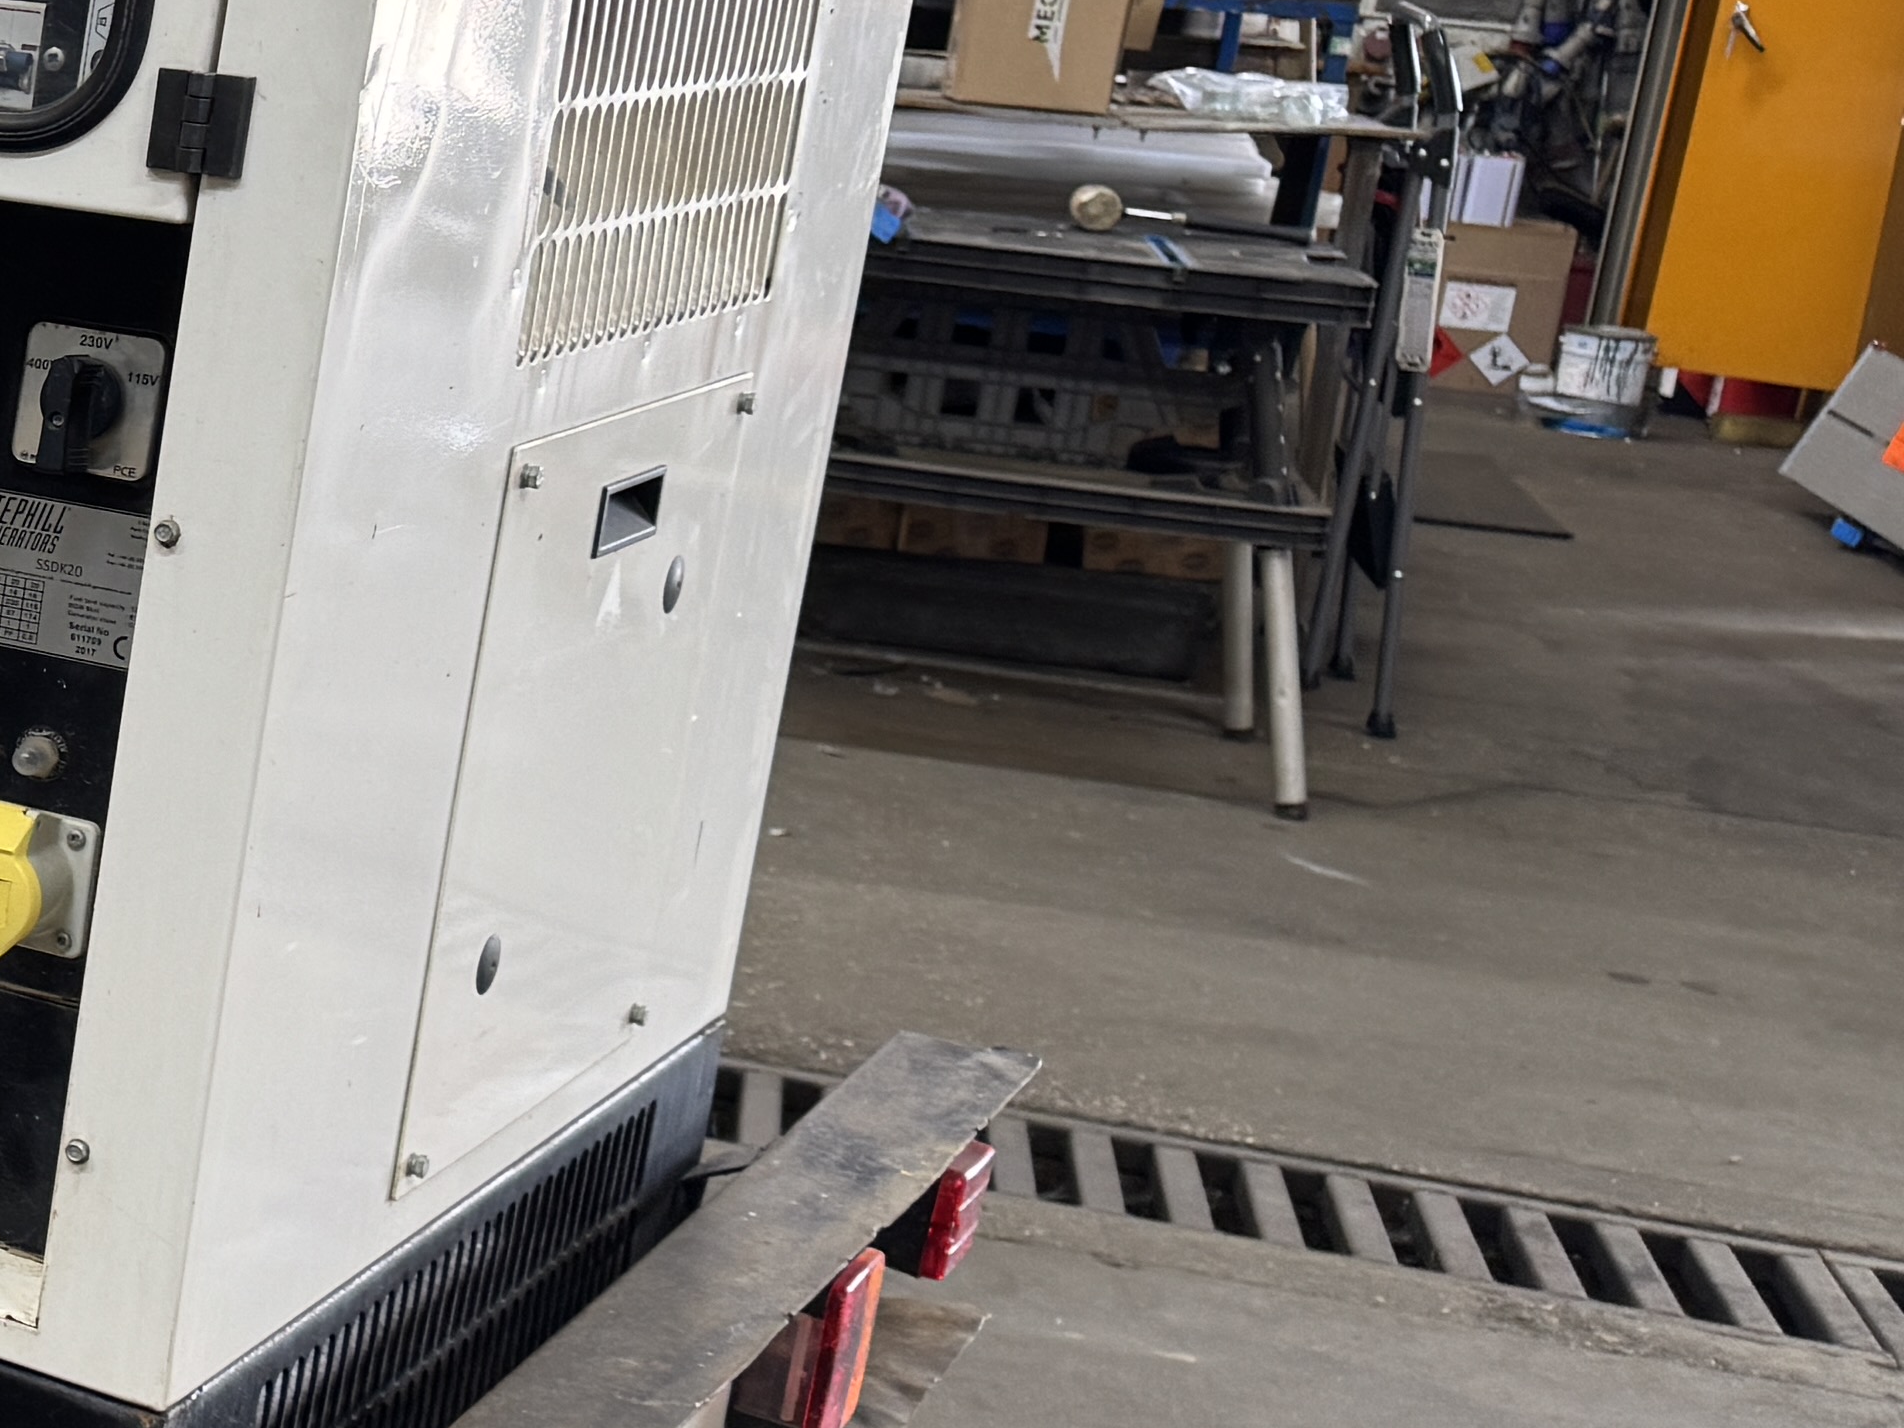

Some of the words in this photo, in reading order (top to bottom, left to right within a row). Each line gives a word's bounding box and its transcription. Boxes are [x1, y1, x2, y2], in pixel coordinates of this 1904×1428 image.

[80, 334, 114, 350] 230V
[26, 358, 51, 370] 400
[128, 372, 160, 386] 115V
[113, 465, 137, 479] PCE
[35, 558, 84, 578] SSDK20
[69, 622, 95, 634] Serial
[75, 645, 96, 656] 2017
